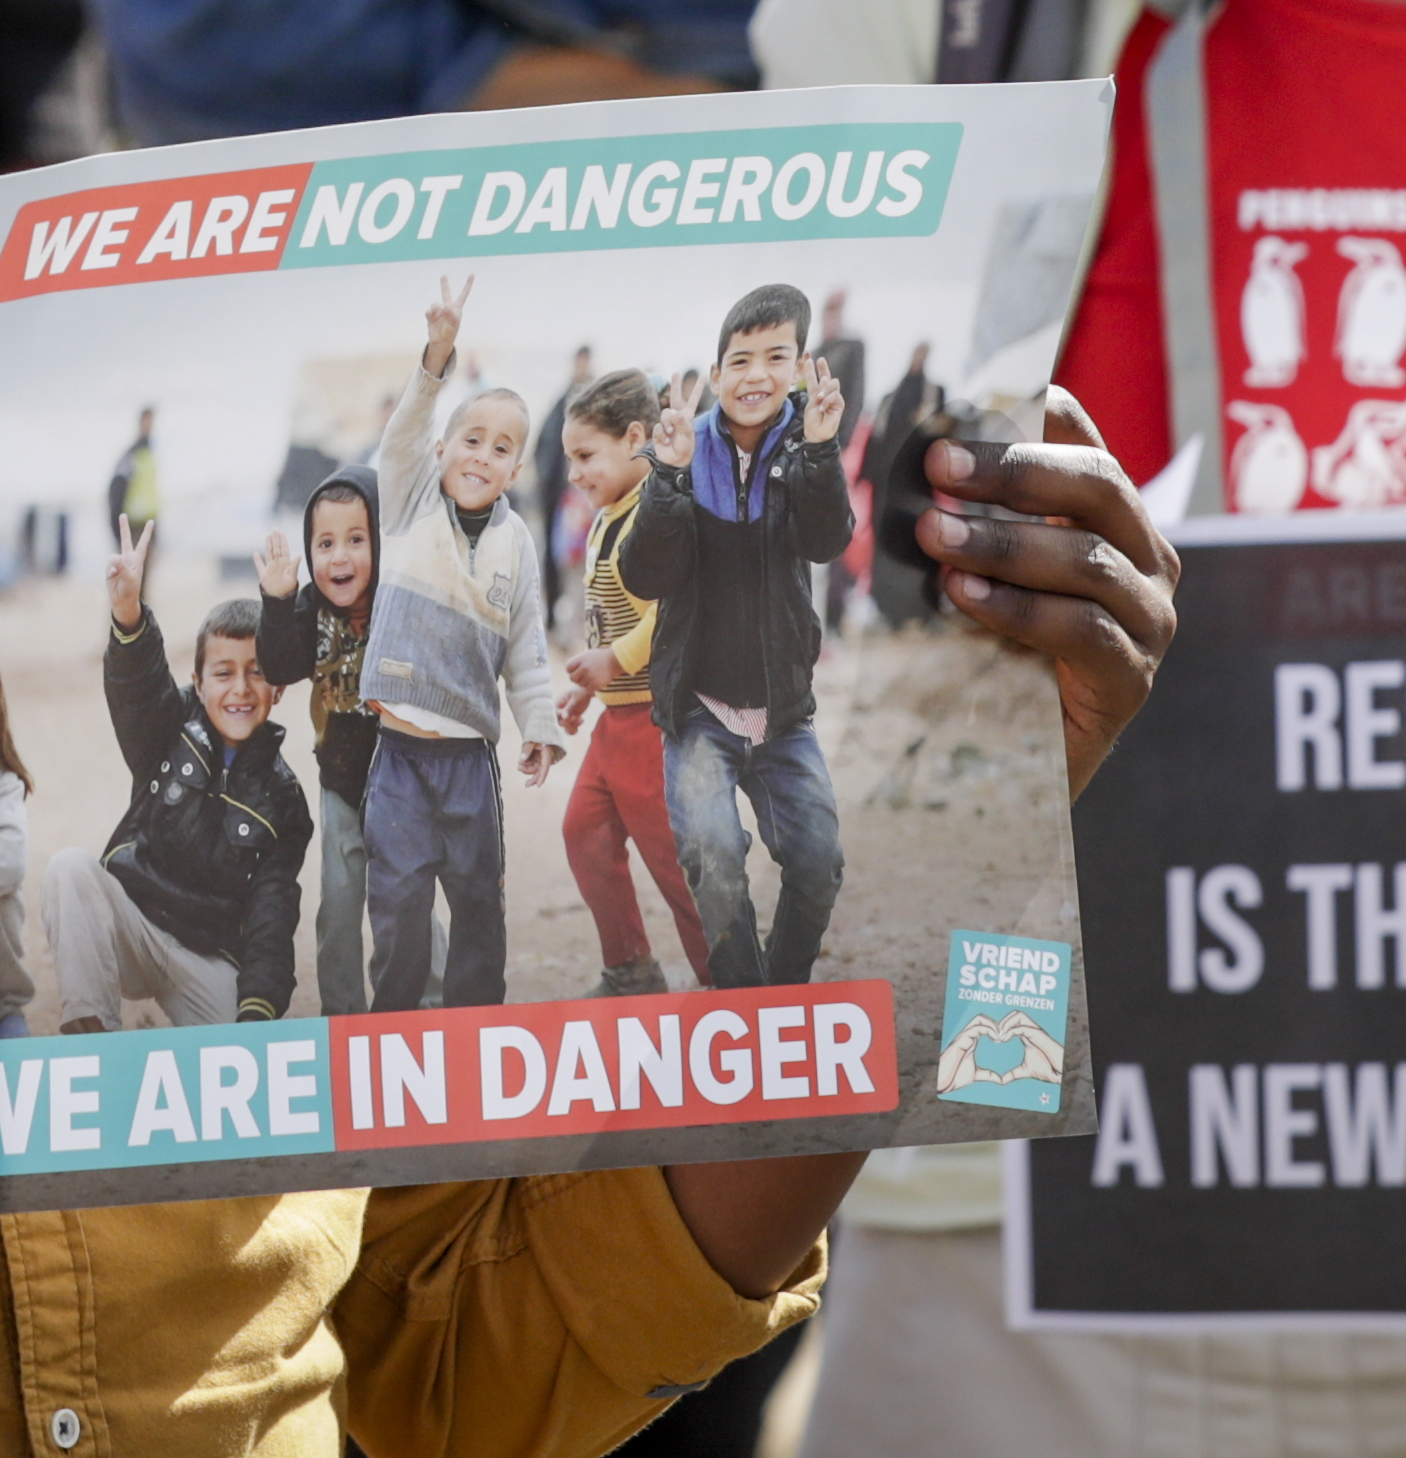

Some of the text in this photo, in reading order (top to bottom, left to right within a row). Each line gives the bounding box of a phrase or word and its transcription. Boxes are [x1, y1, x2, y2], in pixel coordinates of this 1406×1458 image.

[23, 149, 932, 281] WE ARE NOT DANGEROUS
[959, 964, 1058, 995] SCHAP
[962, 940, 1061, 973] VRIEND
[1165, 864, 1264, 994] IS
[958, 988, 1056, 1011] ZONDER GRENZEN
[127, 1039, 321, 1147] ARE
[348, 1030, 448, 1130] IN
[478, 1001, 876, 1121] DANGER
[1091, 1064, 1165, 1189] A
